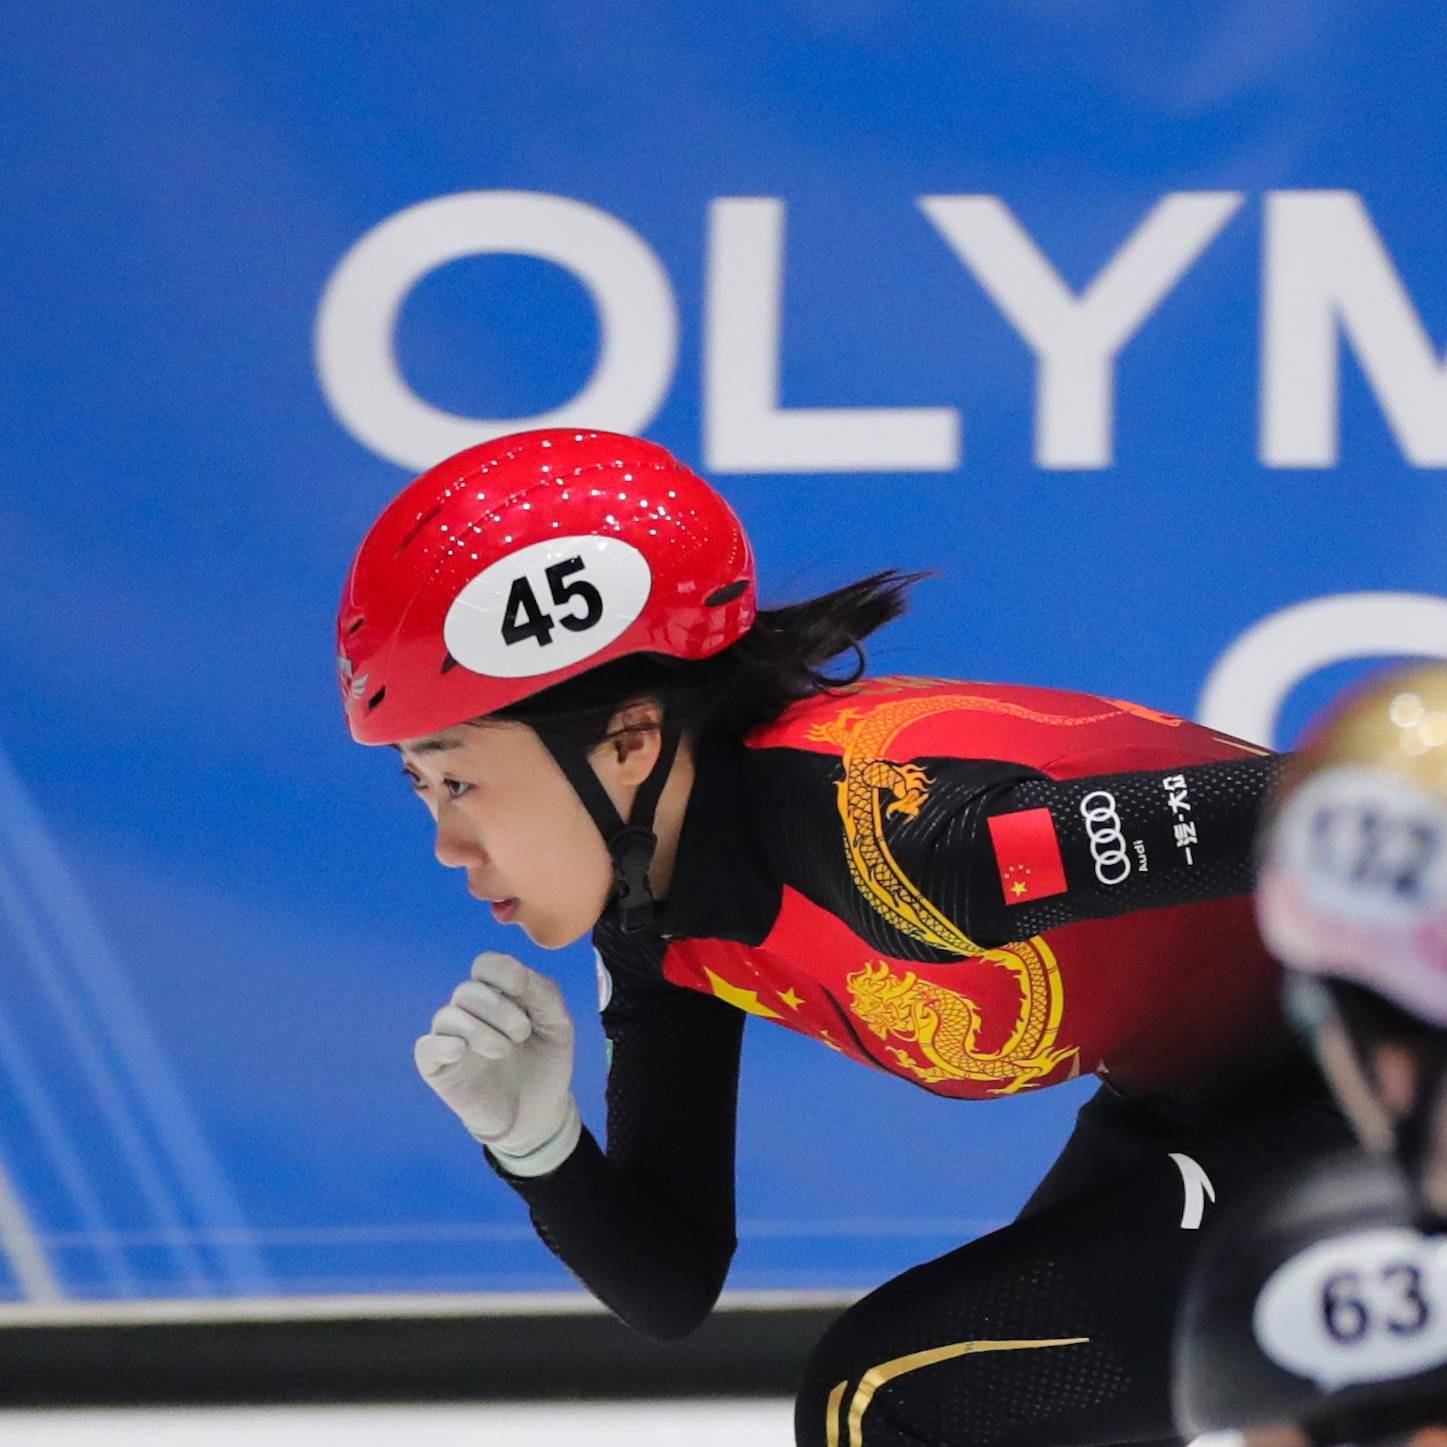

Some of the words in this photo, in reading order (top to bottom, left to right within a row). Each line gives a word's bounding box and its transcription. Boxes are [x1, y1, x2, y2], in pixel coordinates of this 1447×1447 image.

[501, 555, 603, 647] 45
[1133, 839, 1149, 872] Audi
[1320, 1264, 1431, 1348] 63
